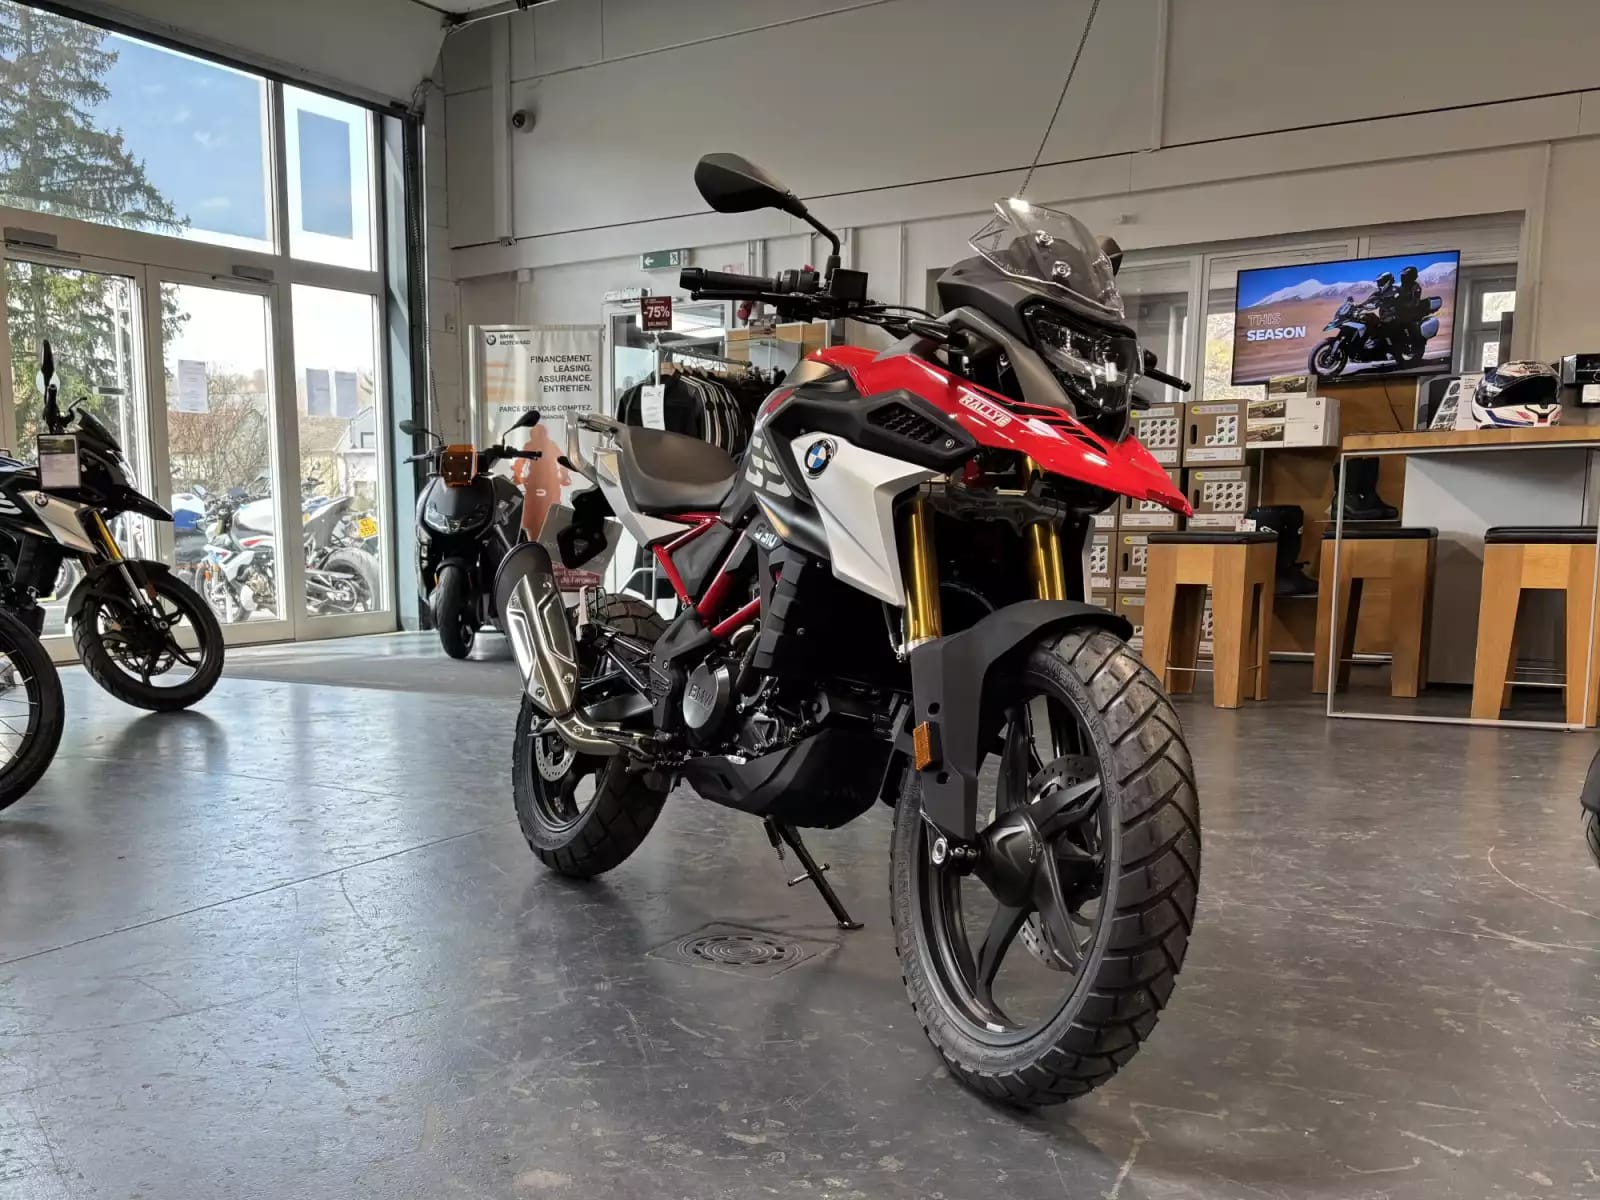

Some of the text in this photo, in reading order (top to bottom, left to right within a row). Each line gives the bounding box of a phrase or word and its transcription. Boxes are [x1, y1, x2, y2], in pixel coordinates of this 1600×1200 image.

[643, 305, 671, 319] -75%
[1247, 312, 1281, 327] THIS
[1246, 325, 1307, 342] SEASON
[530, 354, 593, 364] FINANCEMENT.
[553, 364, 593, 373] LEASING.
[538, 374, 593, 383] ASSURANCE.
[543, 384, 593, 393] ENTRETIEN.
[499, 405, 520, 413] PARCE
[538, 404, 556, 412] VOUS
[557, 403, 593, 412] COMPTEZ.
[688, 683, 714, 709] BMW
